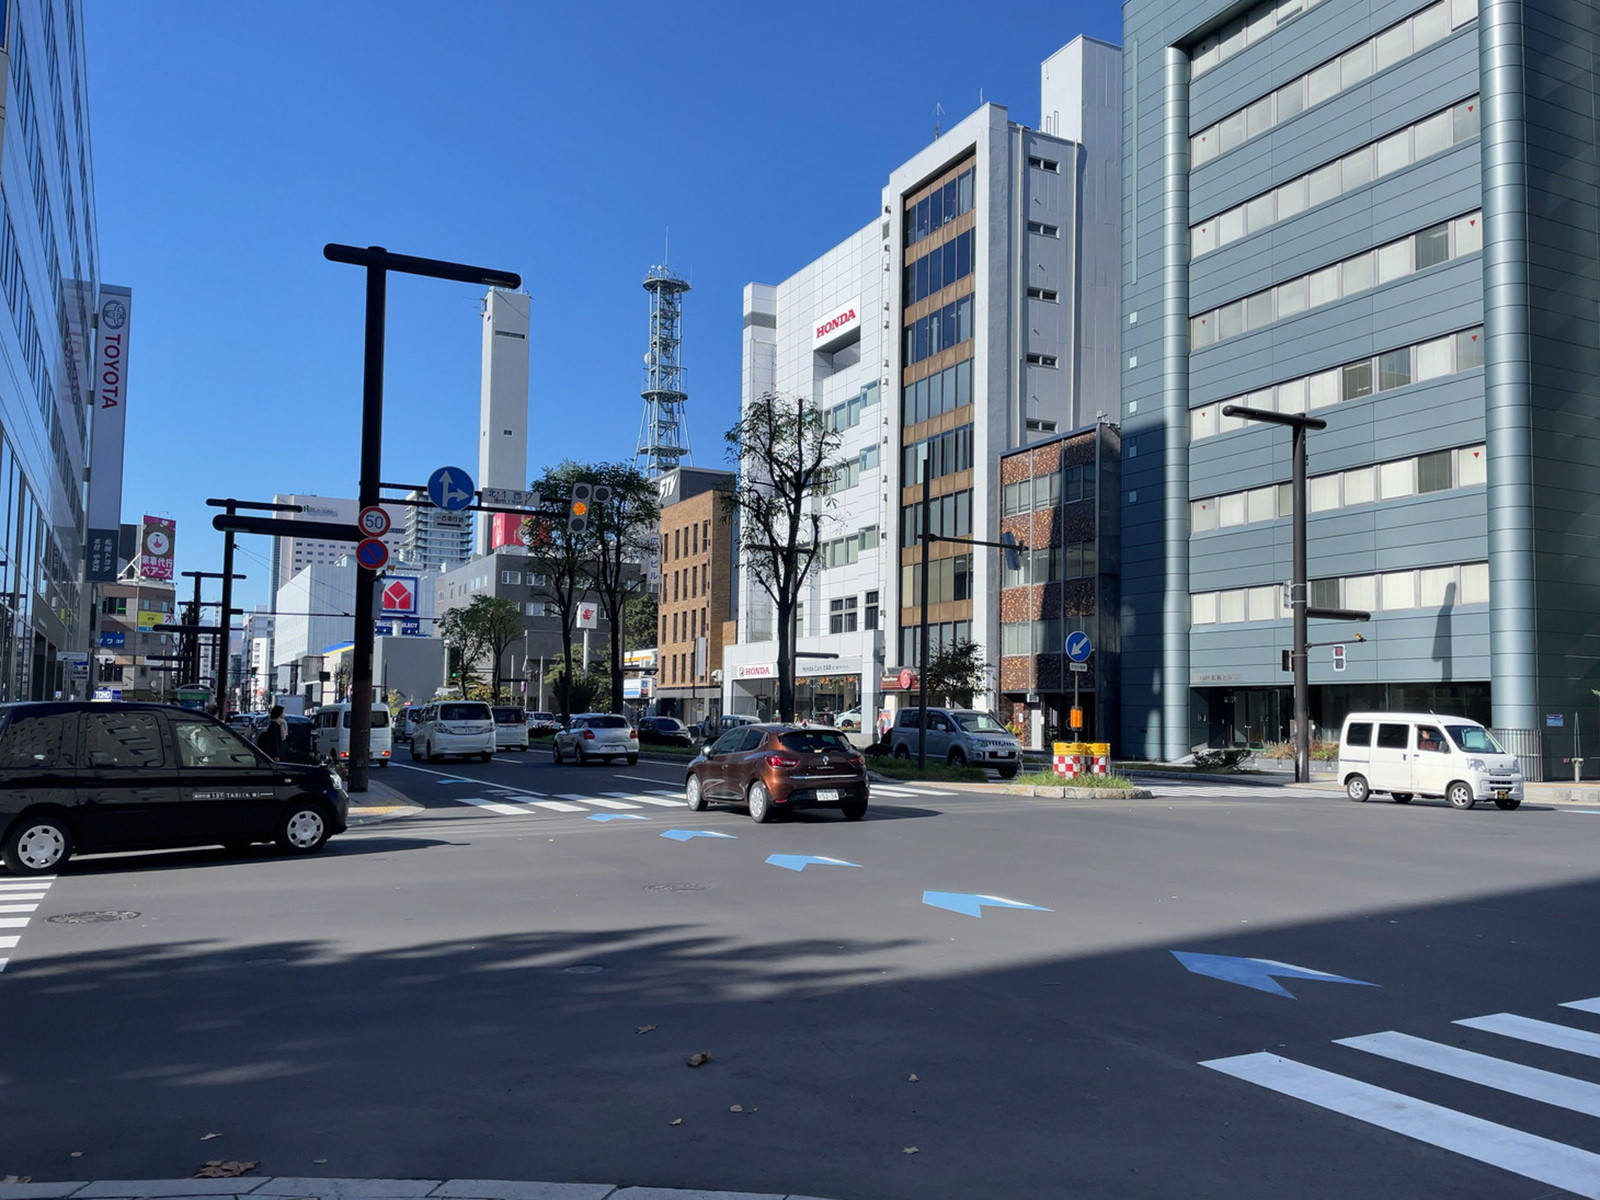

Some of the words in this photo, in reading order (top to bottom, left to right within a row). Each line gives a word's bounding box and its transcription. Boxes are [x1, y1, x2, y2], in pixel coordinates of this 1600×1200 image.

[816, 309, 856, 339] HONDA
[101, 334, 121, 409] TOYOTA
[658, 474, 677, 503] STV
[365, 514, 384, 529] 50
[141, 566, 172, 578] ベアーズ
[745, 666, 770, 675] HONDA
[95, 691, 110, 700] TOHO
